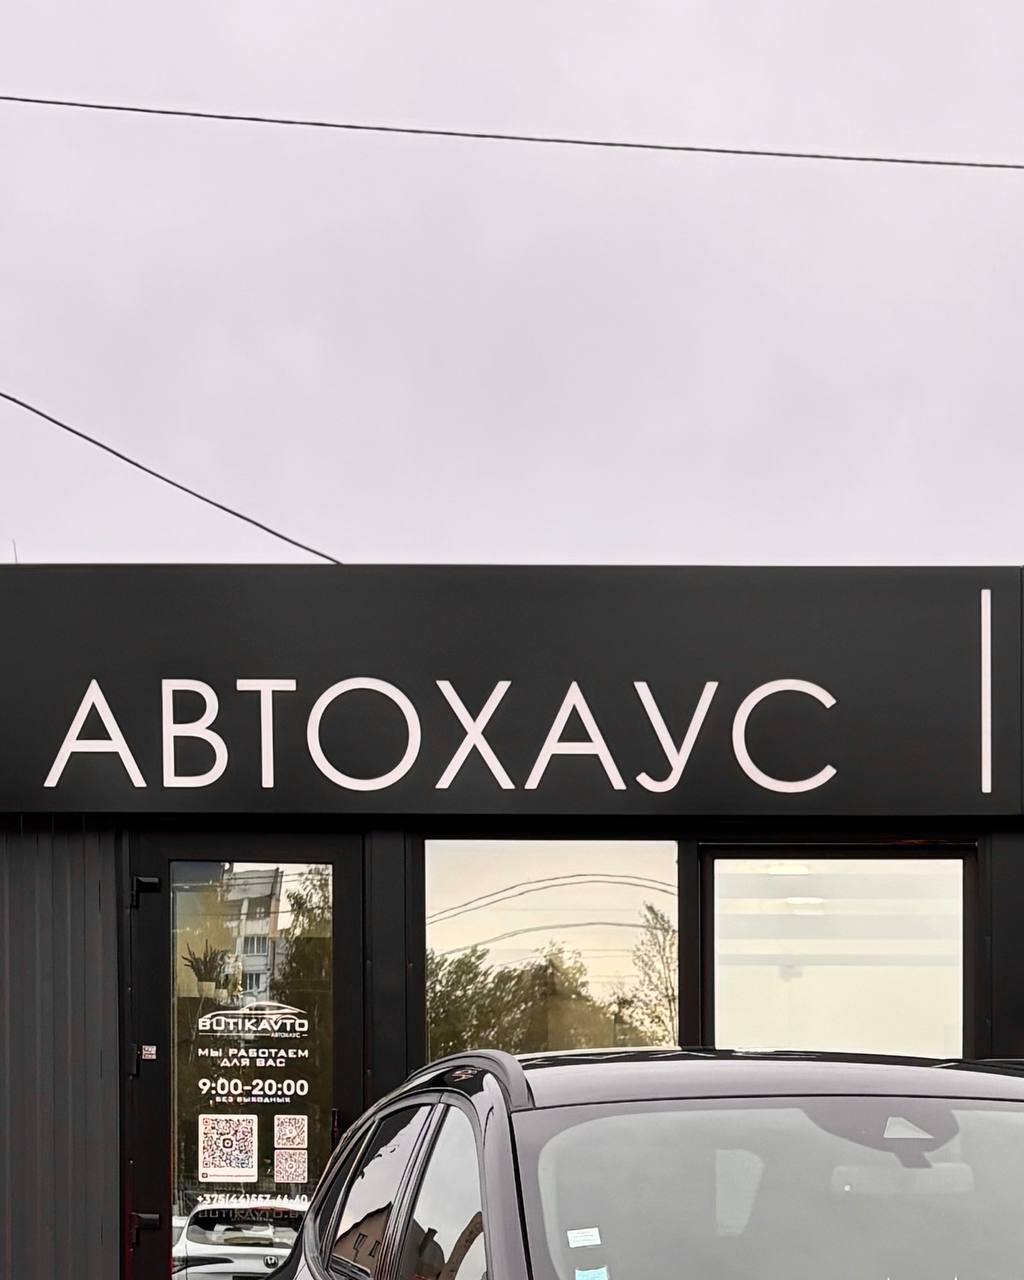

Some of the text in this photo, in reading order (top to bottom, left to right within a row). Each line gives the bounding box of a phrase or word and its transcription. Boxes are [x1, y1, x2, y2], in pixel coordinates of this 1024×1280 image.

[43, 677, 839, 795] АВТОХАУС
[198, 1017, 309, 1032] BUTIKAVTO
[198, 1048, 309, 1059] МЫ РАБОТАЕМ
[220, 1058, 286, 1068] ДЛЯ ВАС
[198, 1077, 309, 1096] 9:00-20:00
[236, 1096, 291, 1104] ВЫХОДНЫХ
